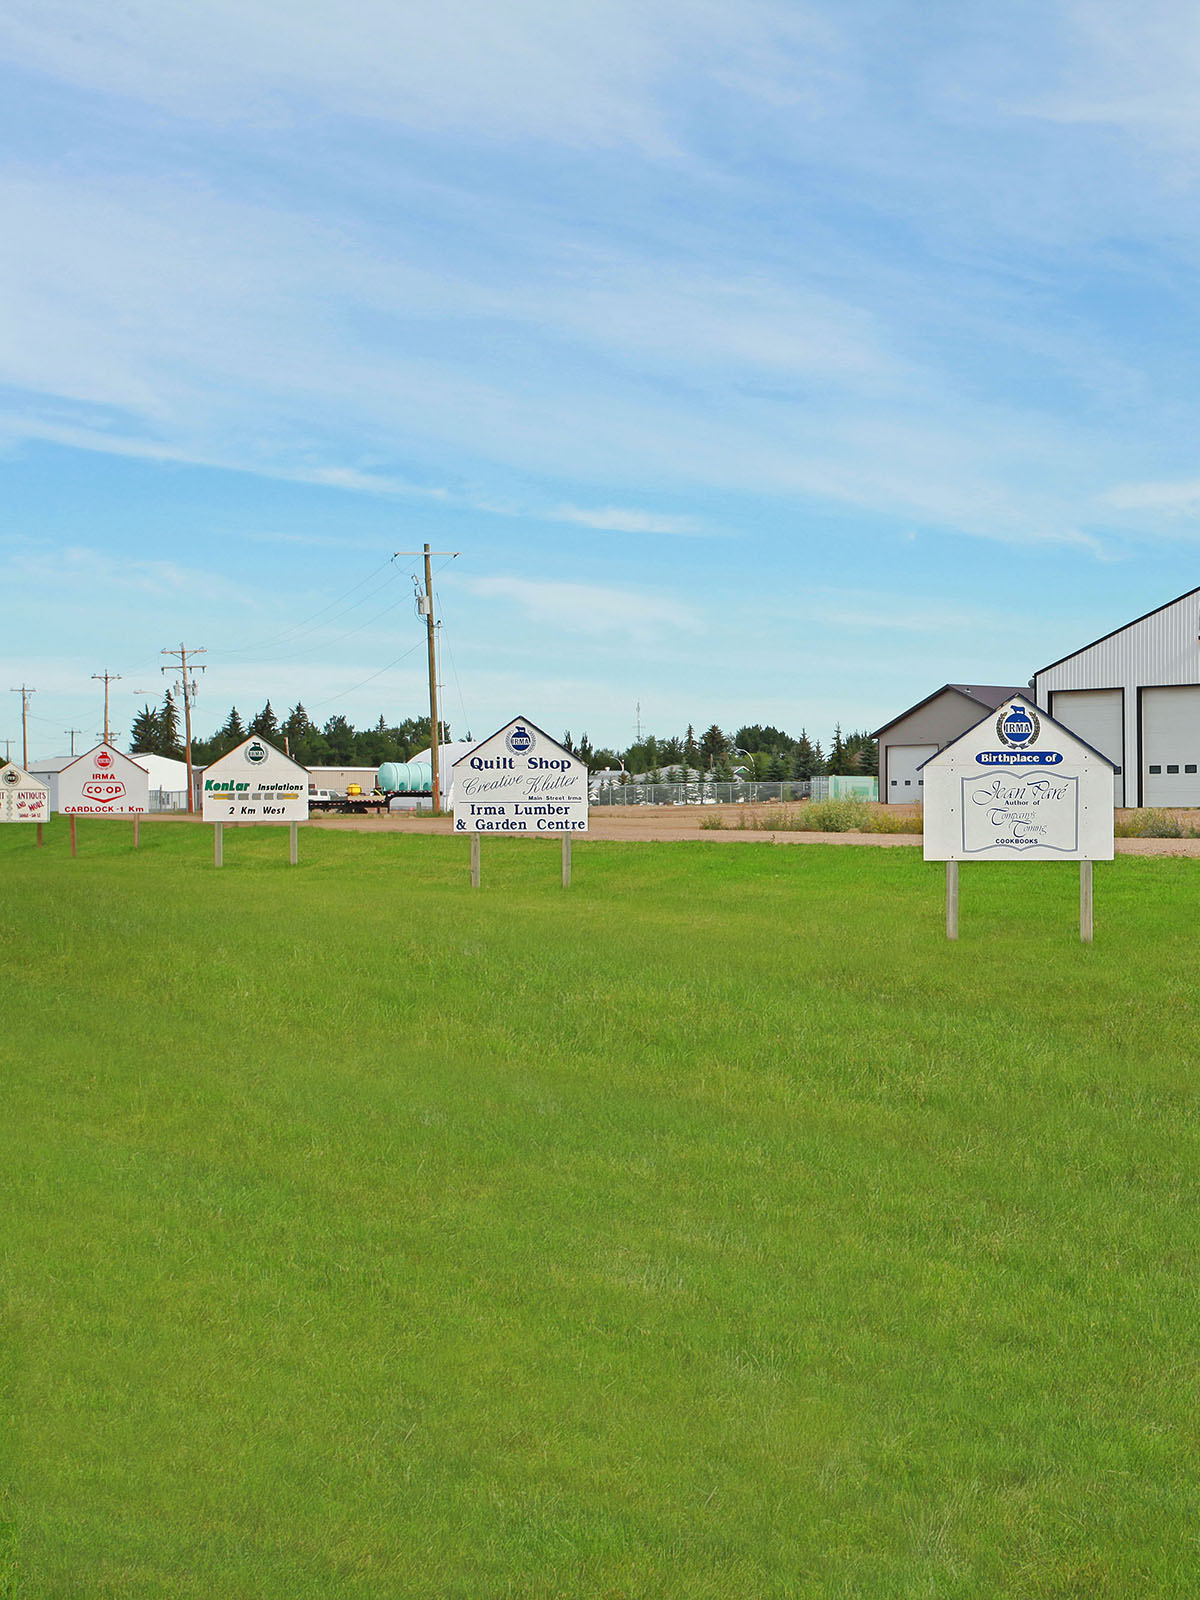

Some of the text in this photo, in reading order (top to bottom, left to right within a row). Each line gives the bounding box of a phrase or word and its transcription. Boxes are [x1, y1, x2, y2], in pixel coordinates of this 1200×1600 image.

[1004, 723, 1031, 734] IRMA
[512, 737, 529, 746] IRMA
[470, 756, 572, 772] Quilt Shop
[980, 753, 1058, 765] Birthplace of
[257, 783, 304, 791] Insulations
[462, 773, 580, 796] Creative Klutter
[17, 792, 47, 800] ANTIQUES
[971, 780, 1069, 806] Jean Paré
[470, 804, 570, 815] Irma Lumber
[456, 818, 586, 830] & Garden Centre
